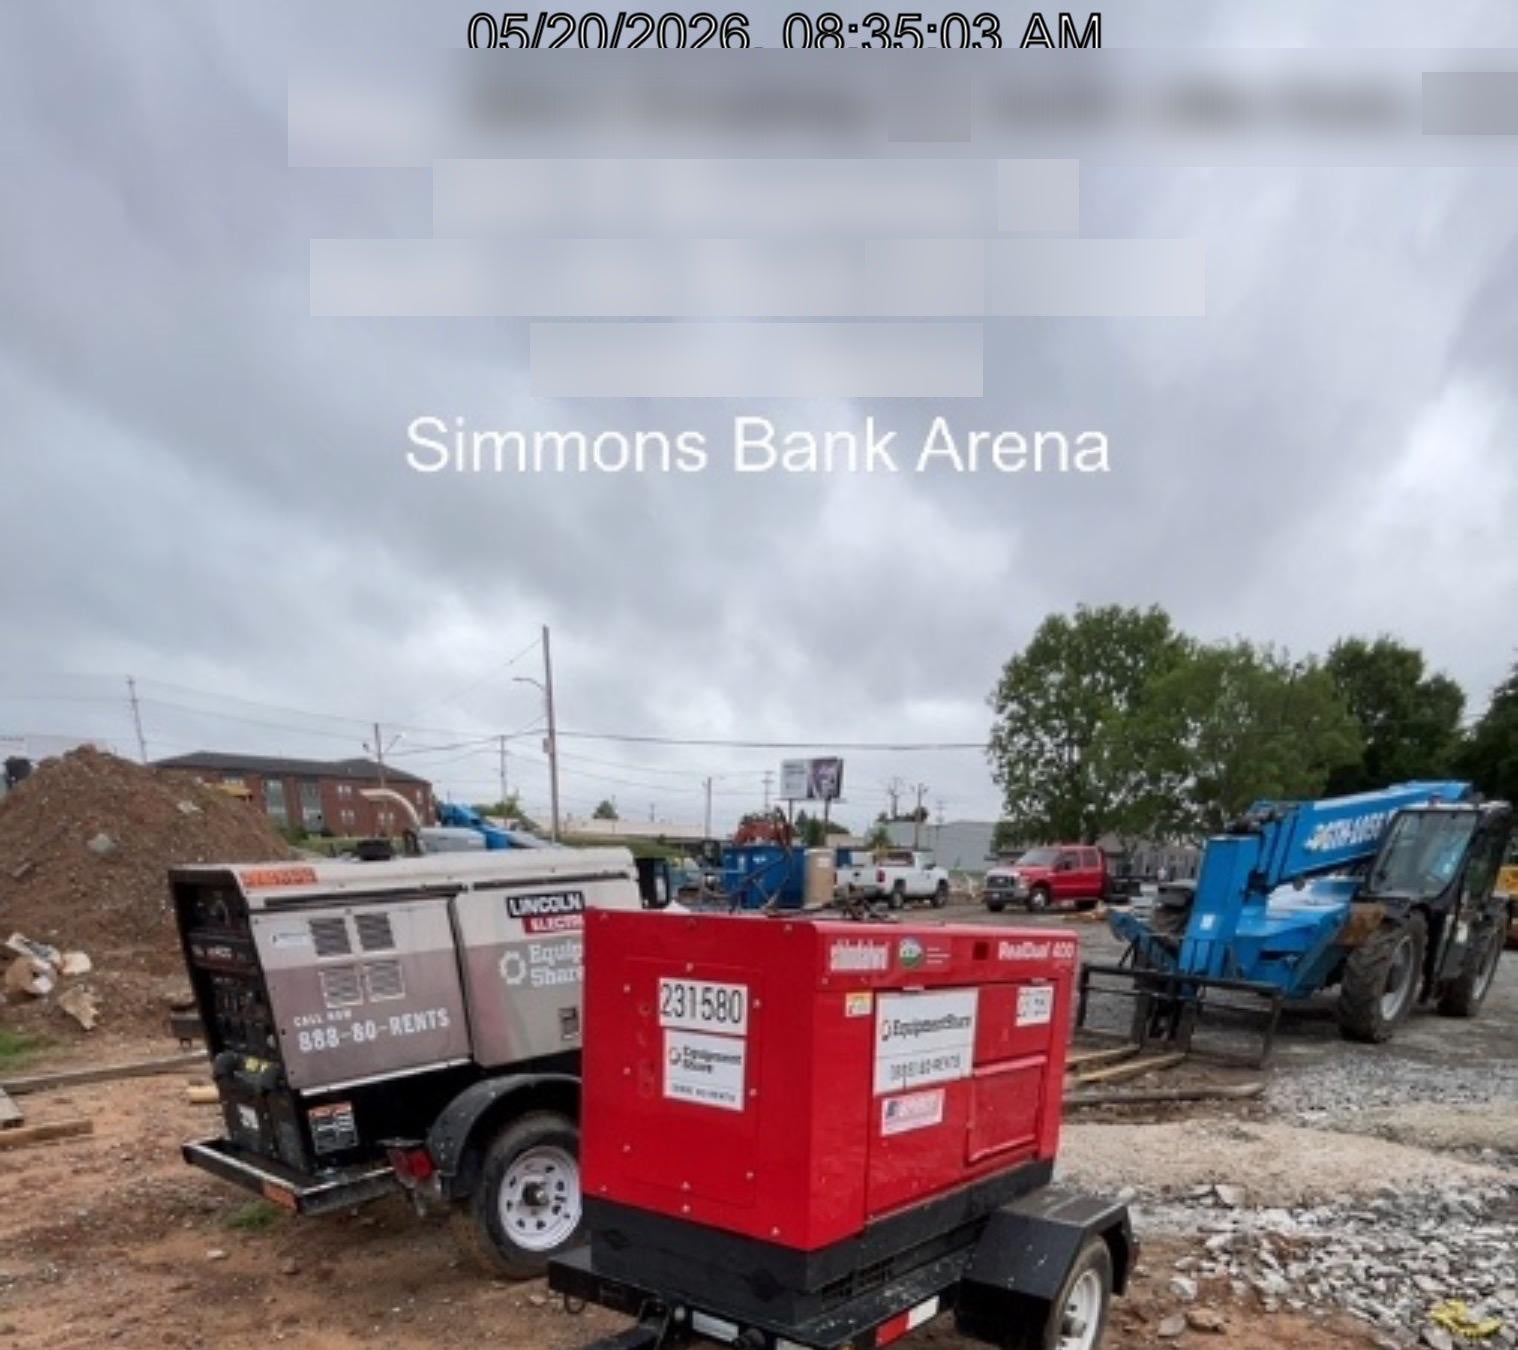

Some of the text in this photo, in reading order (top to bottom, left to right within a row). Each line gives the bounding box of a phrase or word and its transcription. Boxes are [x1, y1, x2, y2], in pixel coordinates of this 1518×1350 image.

[509, 893, 581, 916] LINCOLN
[661, 983, 743, 1024] 231580
[298, 1007, 450, 1052] 888-80-RENTS
